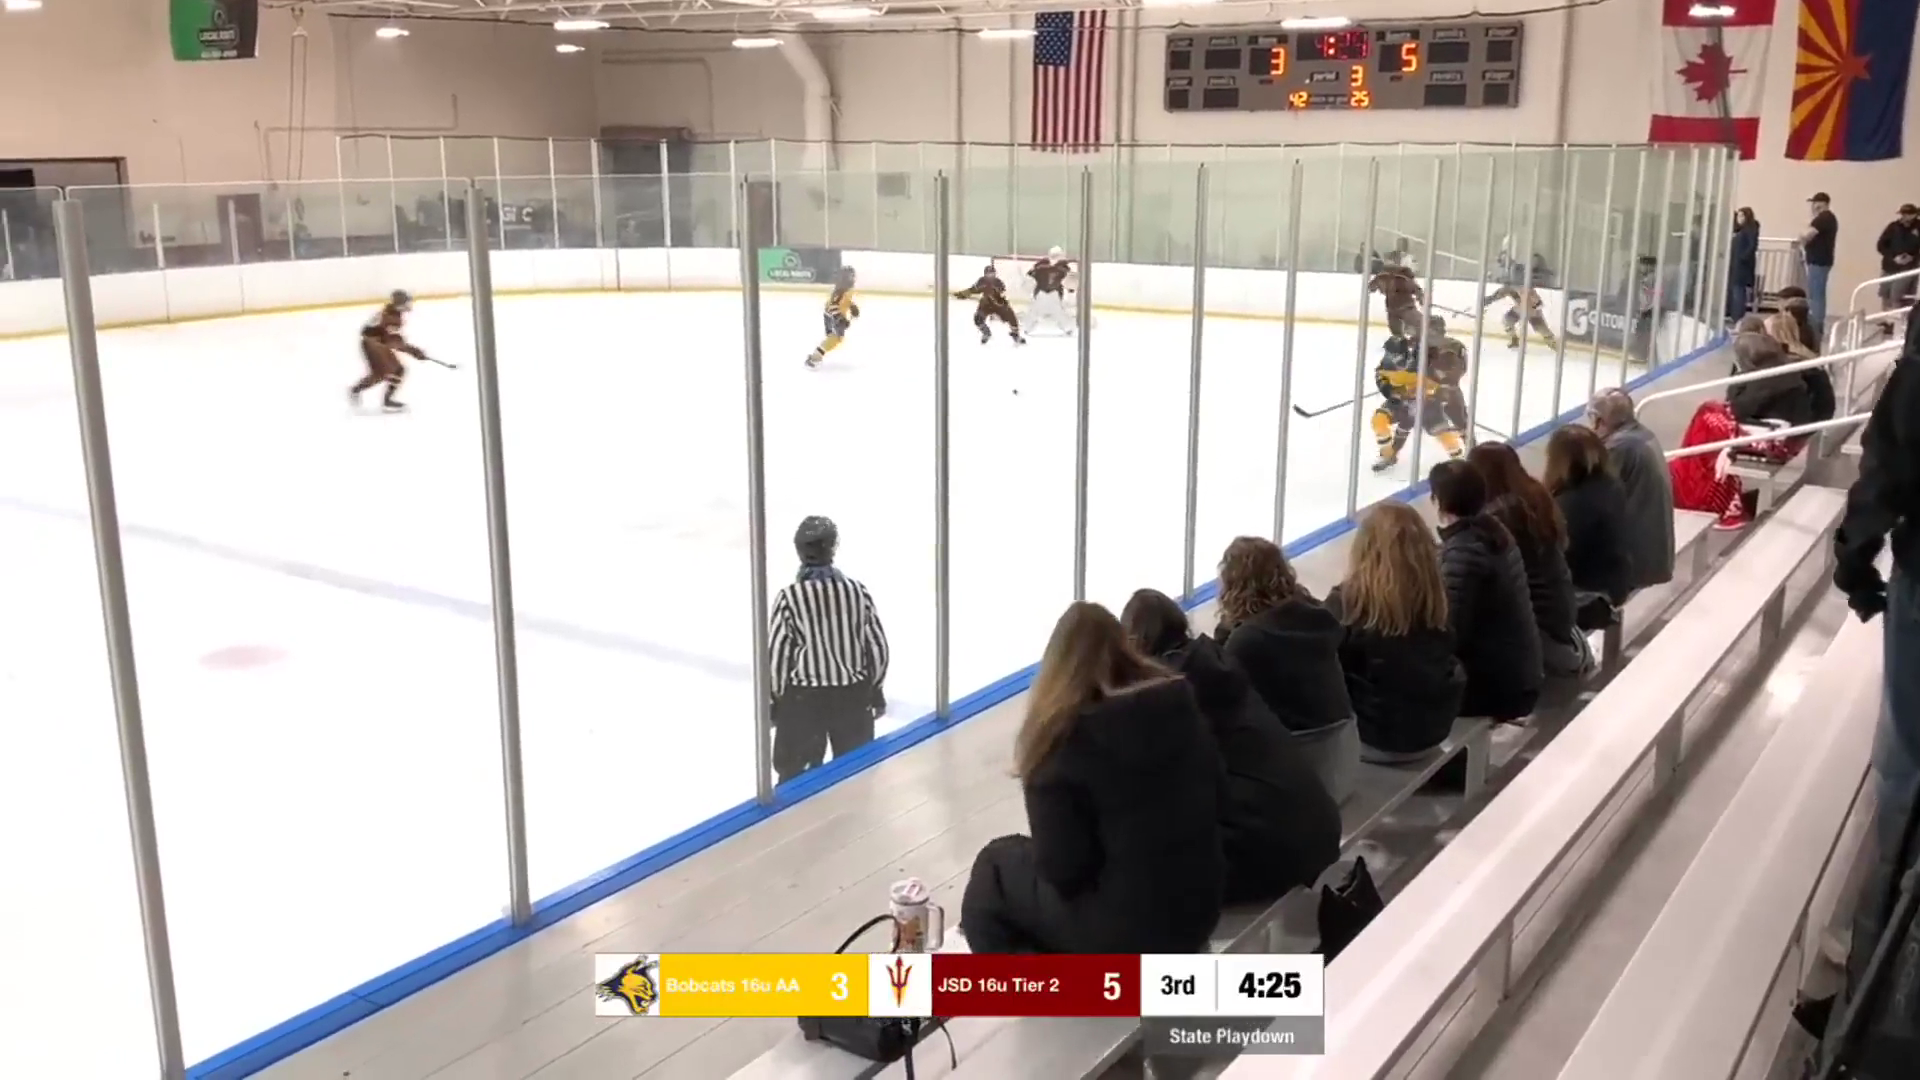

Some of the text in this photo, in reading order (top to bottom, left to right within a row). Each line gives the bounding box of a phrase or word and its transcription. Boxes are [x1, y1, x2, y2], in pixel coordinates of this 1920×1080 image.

[1270, 47, 1285, 75] 3
[1401, 42, 1417, 72] 5
[1350, 65, 1364, 87] 3
[1289, 91, 1308, 108] 42
[1350, 90, 1370, 107] 25
